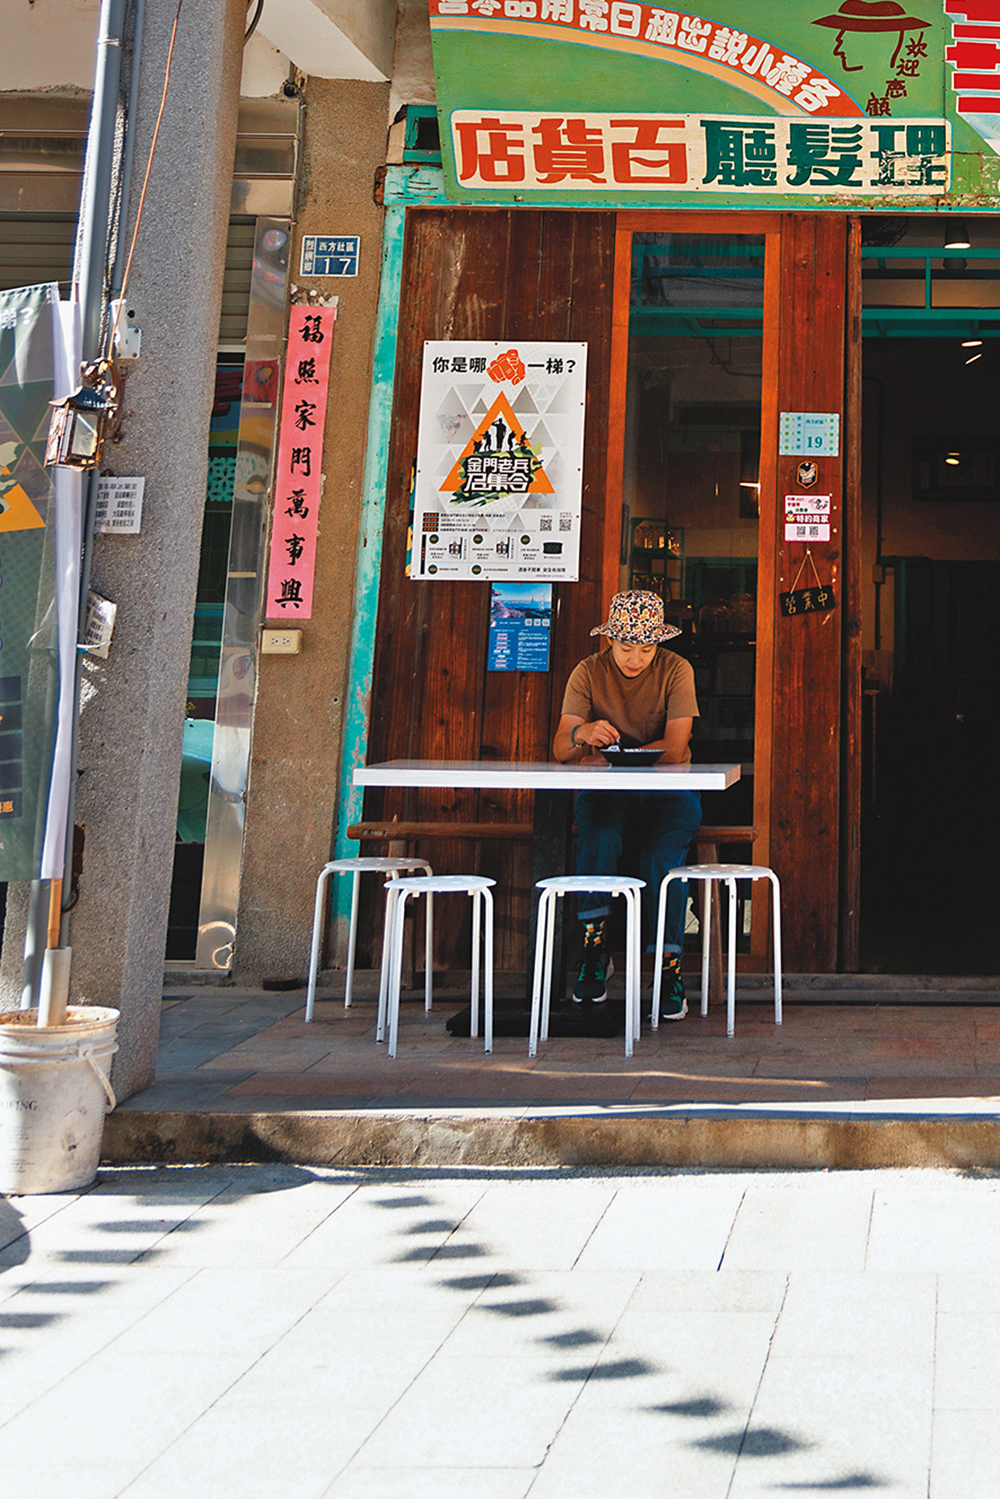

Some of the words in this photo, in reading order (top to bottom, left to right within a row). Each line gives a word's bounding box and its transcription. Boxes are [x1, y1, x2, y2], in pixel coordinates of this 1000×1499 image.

[319, 242, 354, 252] 西方社區
[324, 258, 351, 274] 17
[433, 357, 486, 373] 你是哪
[528, 357, 576, 374] 一梯?
[807, 436, 823, 449] 19
[275, 315, 324, 609] 福照家門萬事興
[467, 457, 529, 473] 金門老兵
[464, 473, 529, 491] 召集令
[785, 590, 828, 614] 營業中
